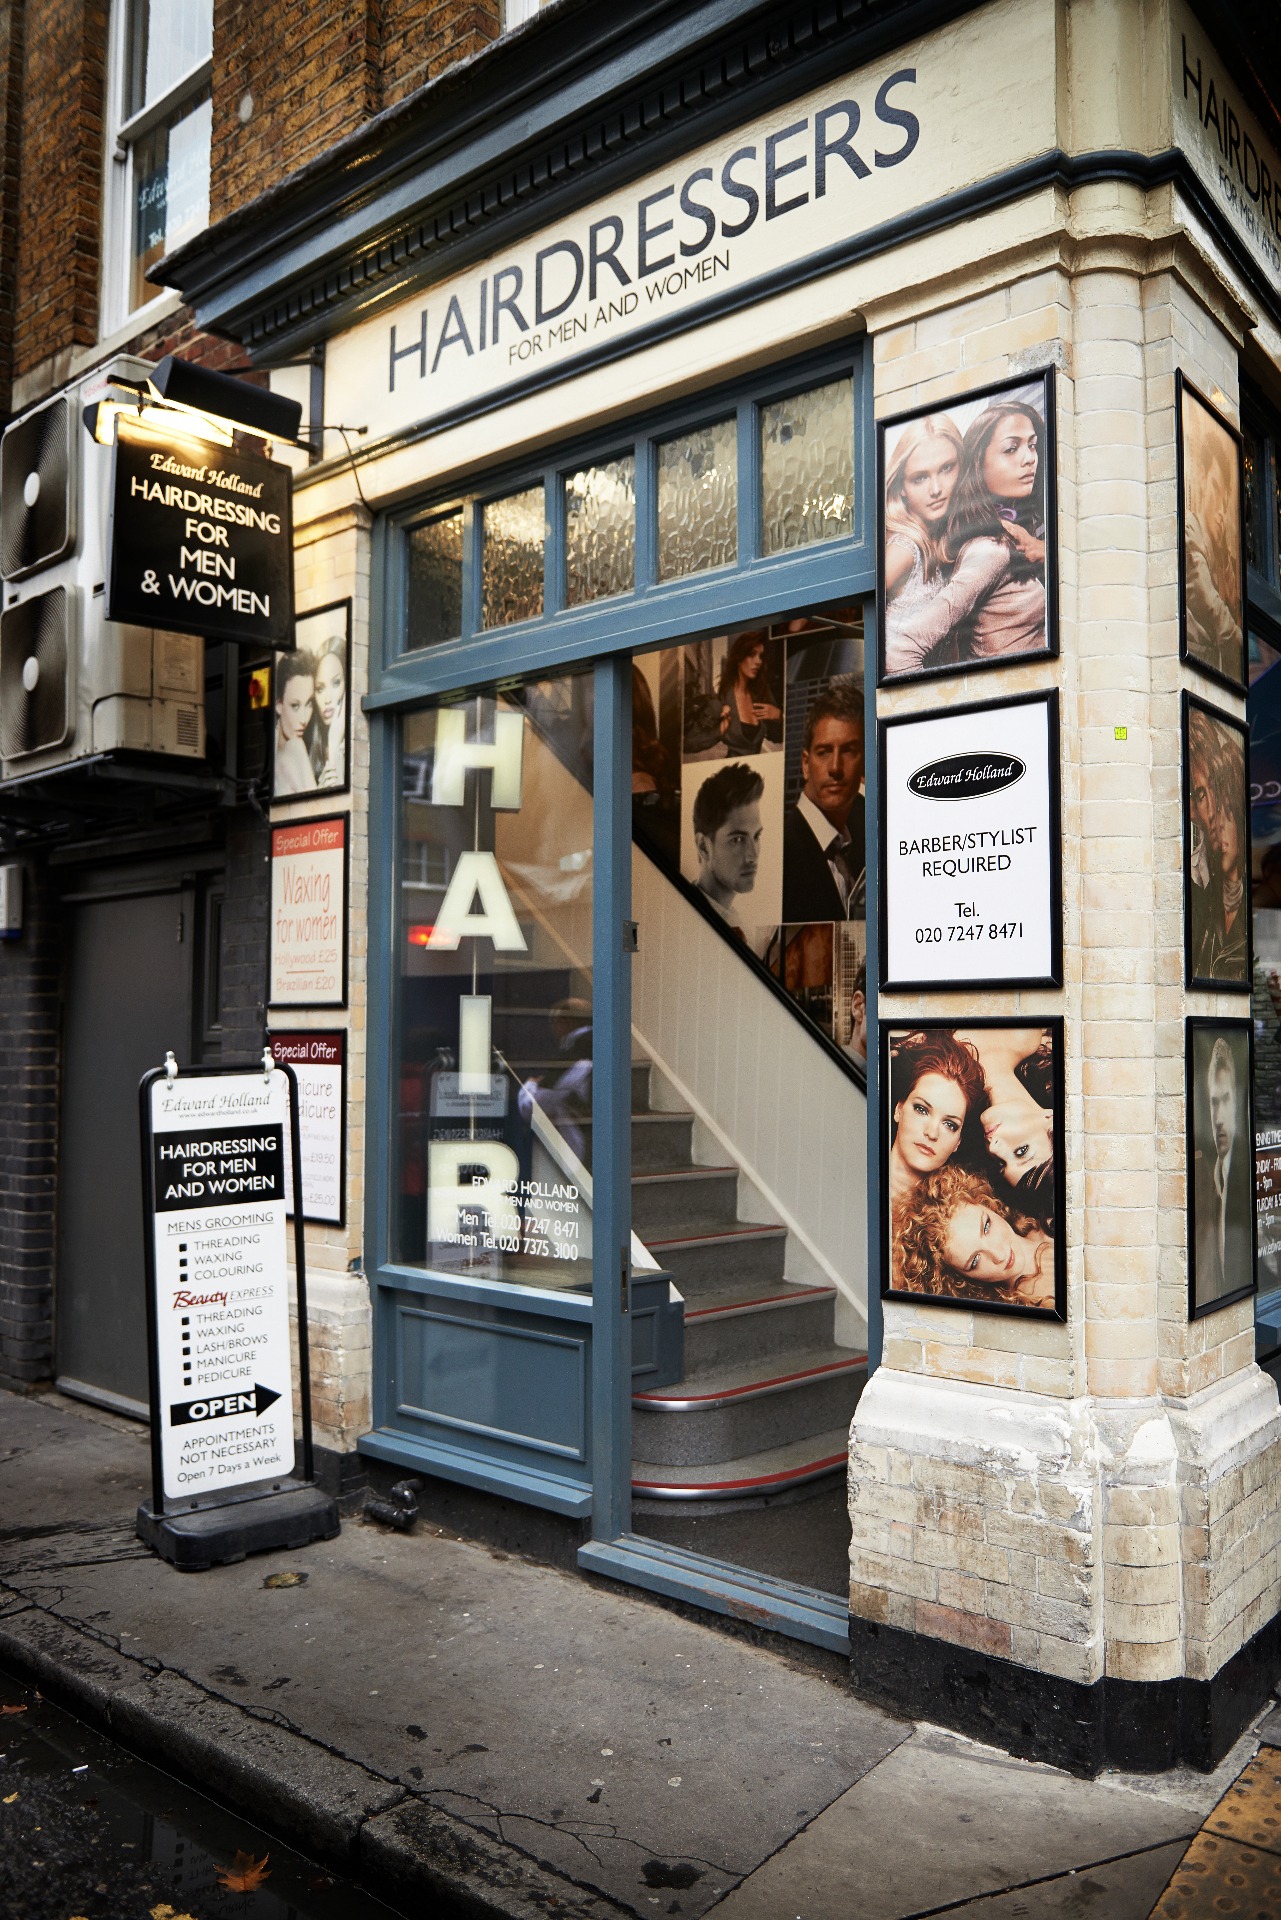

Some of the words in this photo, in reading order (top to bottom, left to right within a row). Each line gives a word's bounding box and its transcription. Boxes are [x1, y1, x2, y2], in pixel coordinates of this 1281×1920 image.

[388, 68, 921, 392] HAIRDRESSERS
[509, 334, 543, 366] FOR
[549, 312, 588, 350] MEN
[594, 291, 639, 329] AND
[645, 249, 731, 302] WOMEN
[150, 453, 207, 483] Edward
[206, 469, 265, 499] Holland
[131, 475, 281, 535] HAIRDRESSING
[185, 517, 230, 548] FOR
[180, 545, 236, 580] MEN
[141, 569, 161, 596] &
[168, 573, 270, 618] WOMEN
[916, 768, 964, 789] Edward
[964, 762, 1015, 783] Holland
[276, 832, 311, 855] Special
[312, 828, 339, 845] Offer
[899, 826, 1038, 856] BARBER/STYLIST
[922, 854, 1012, 877] REQUIRED
[282, 864, 331, 914] Waxing
[954, 902, 980, 918] Tel.
[276, 909, 292, 943] for
[296, 914, 337, 942] women
[915, 927, 942, 944] 020
[947, 924, 984, 942] 7247
[988, 922, 1024, 939] 8471
[275, 950, 316, 969] Hollywood
[318, 949, 337, 963] £25
[276, 978, 313, 991] Brazilian
[315, 976, 336, 990] £20
[274, 1042, 309, 1062] Special
[310, 1043, 337, 1059] Offer
[162, 1094, 218, 1113] Edward
[219, 1090, 272, 1109] Holland
[160, 1136, 277, 1160] HAIRDRESSING
[183, 1161, 217, 1178] FOR
[220, 1157, 256, 1174] MEN
[165, 1182, 204, 1199] AND
[208, 1174, 275, 1194] WOMEN
[521, 1181, 579, 1200] HOLLAND
[524, 1198, 543, 1210] AND
[545, 1200, 579, 1214] WOMEN
[167, 1219, 202, 1233] MENS
[205, 1211, 274, 1230] GROOMING
[456, 1208, 479, 1226] Men
[501, 1214, 521, 1231] 020
[525, 1216, 550, 1235] 7247
[554, 1220, 579, 1239] 8471
[194, 1234, 260, 1251] THREADING
[437, 1226, 477, 1247] Women
[480, 1232, 498, 1250] Tel.
[499, 1235, 519, 1253] 020
[523, 1238, 550, 1257] 7375
[553, 1242, 579, 1261] 3100
[194, 1251, 243, 1265] WAXING
[194, 1263, 263, 1281] COLOURING
[173, 1290, 229, 1309] Beauty
[230, 1285, 274, 1300] EXPRESS
[197, 1306, 263, 1324] THREADING
[197, 1323, 245, 1339] WAXING
[197, 1334, 268, 1354] LASH/BROWS
[197, 1351, 257, 1369] MANICURE
[197, 1367, 252, 1384] PEDICURE
[189, 1392, 257, 1420] OPEN
[183, 1424, 275, 1451] APPOINTMENTS
[180, 1451, 207, 1466] NOT
[212, 1437, 277, 1460] NECESSARY
[177, 1469, 205, 1484] Open
[208, 1466, 215, 1477] 7
[218, 1462, 242, 1476] Days
[244, 1461, 250, 1469] a
[254, 1454, 282, 1467] Week
